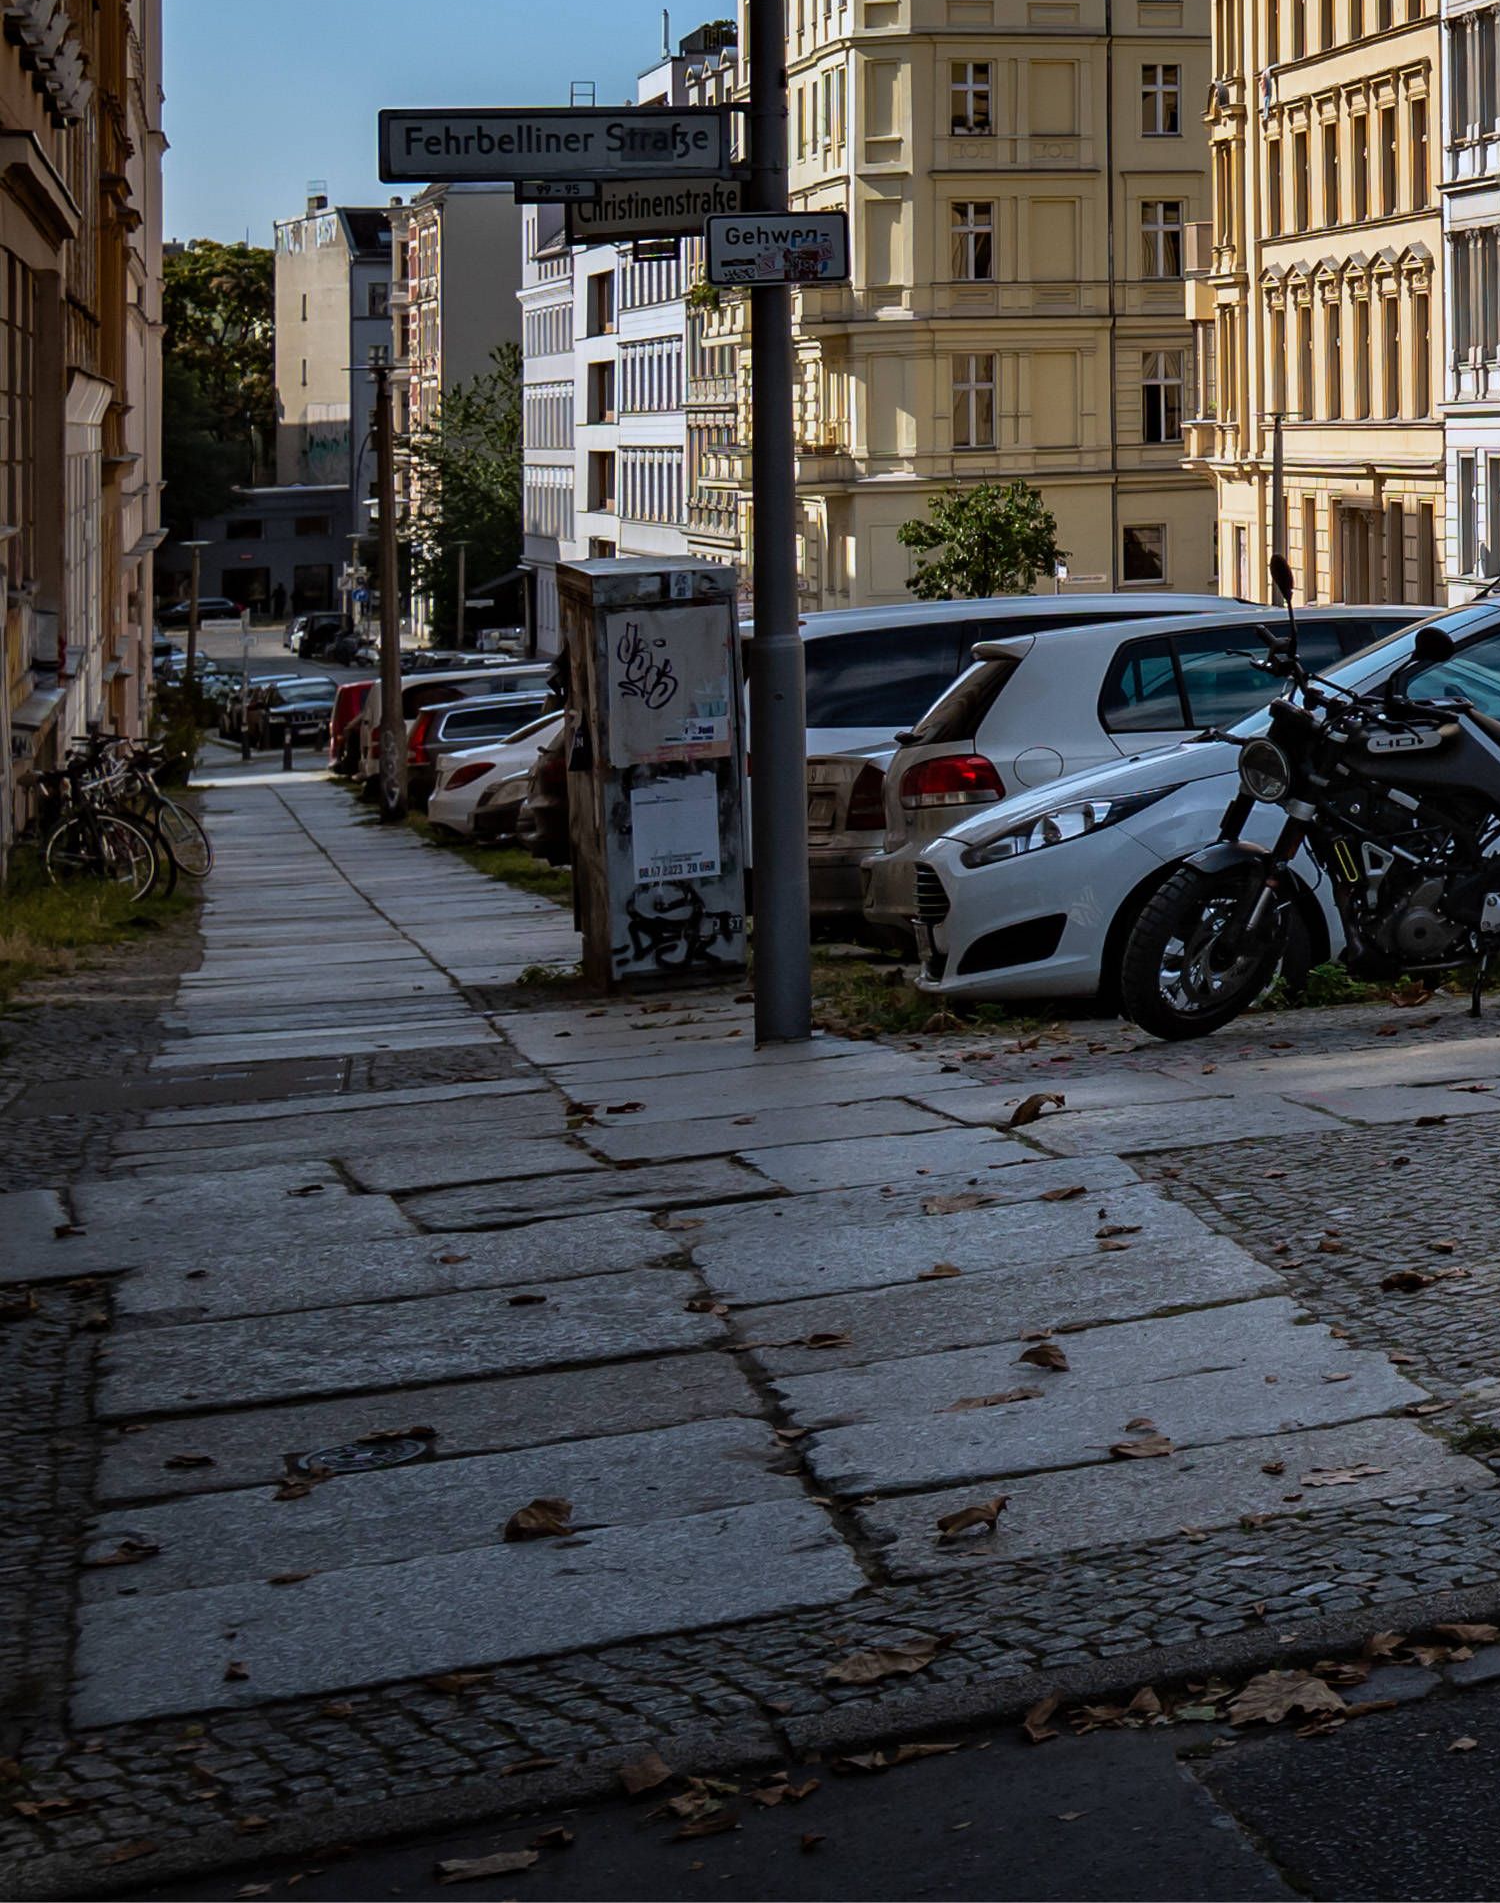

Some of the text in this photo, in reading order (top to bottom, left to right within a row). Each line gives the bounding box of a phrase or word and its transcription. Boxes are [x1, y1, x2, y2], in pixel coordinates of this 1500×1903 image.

[404, 121, 709, 159] Fehrbelliner Straße
[577, 182, 737, 224] Christinenstraße
